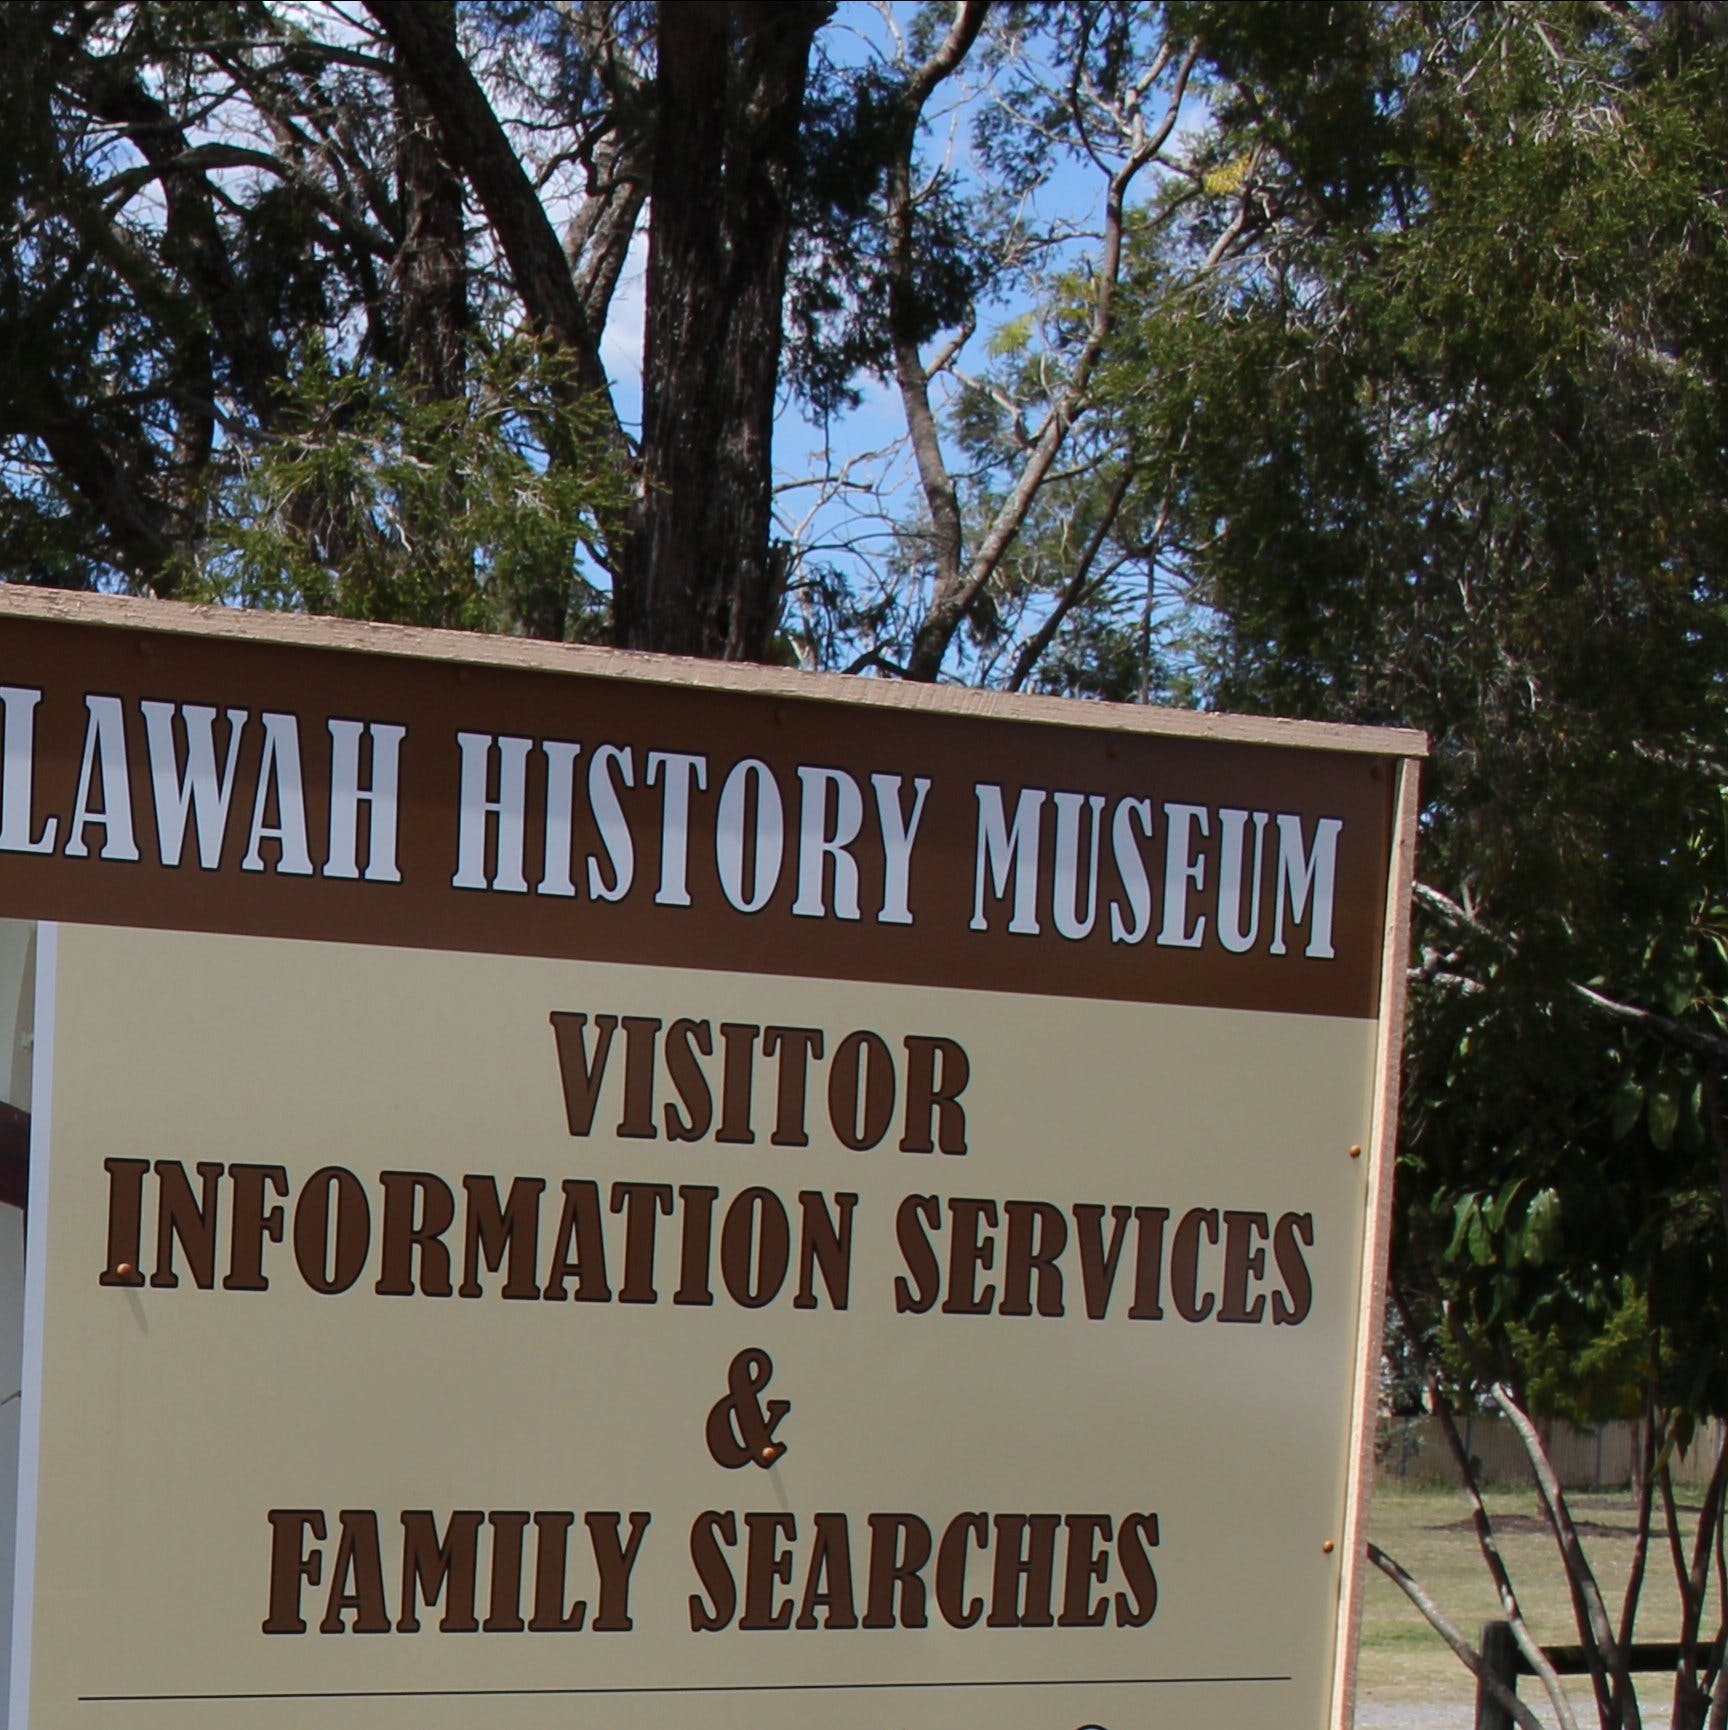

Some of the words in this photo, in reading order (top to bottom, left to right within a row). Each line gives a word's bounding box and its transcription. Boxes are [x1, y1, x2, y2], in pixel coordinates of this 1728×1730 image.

[451, 730, 932, 928] HISTORY
[970, 783, 1343, 960] MUSEUM
[547, 1010, 972, 1157] VISITOR
[98, 1156, 860, 1313] INFORMATION
[893, 1193, 1315, 1327] SERVICES
[705, 1347, 792, 1471] &
[260, 1508, 653, 1636] FAMILY
[687, 1511, 1161, 1633] SEARCHES
